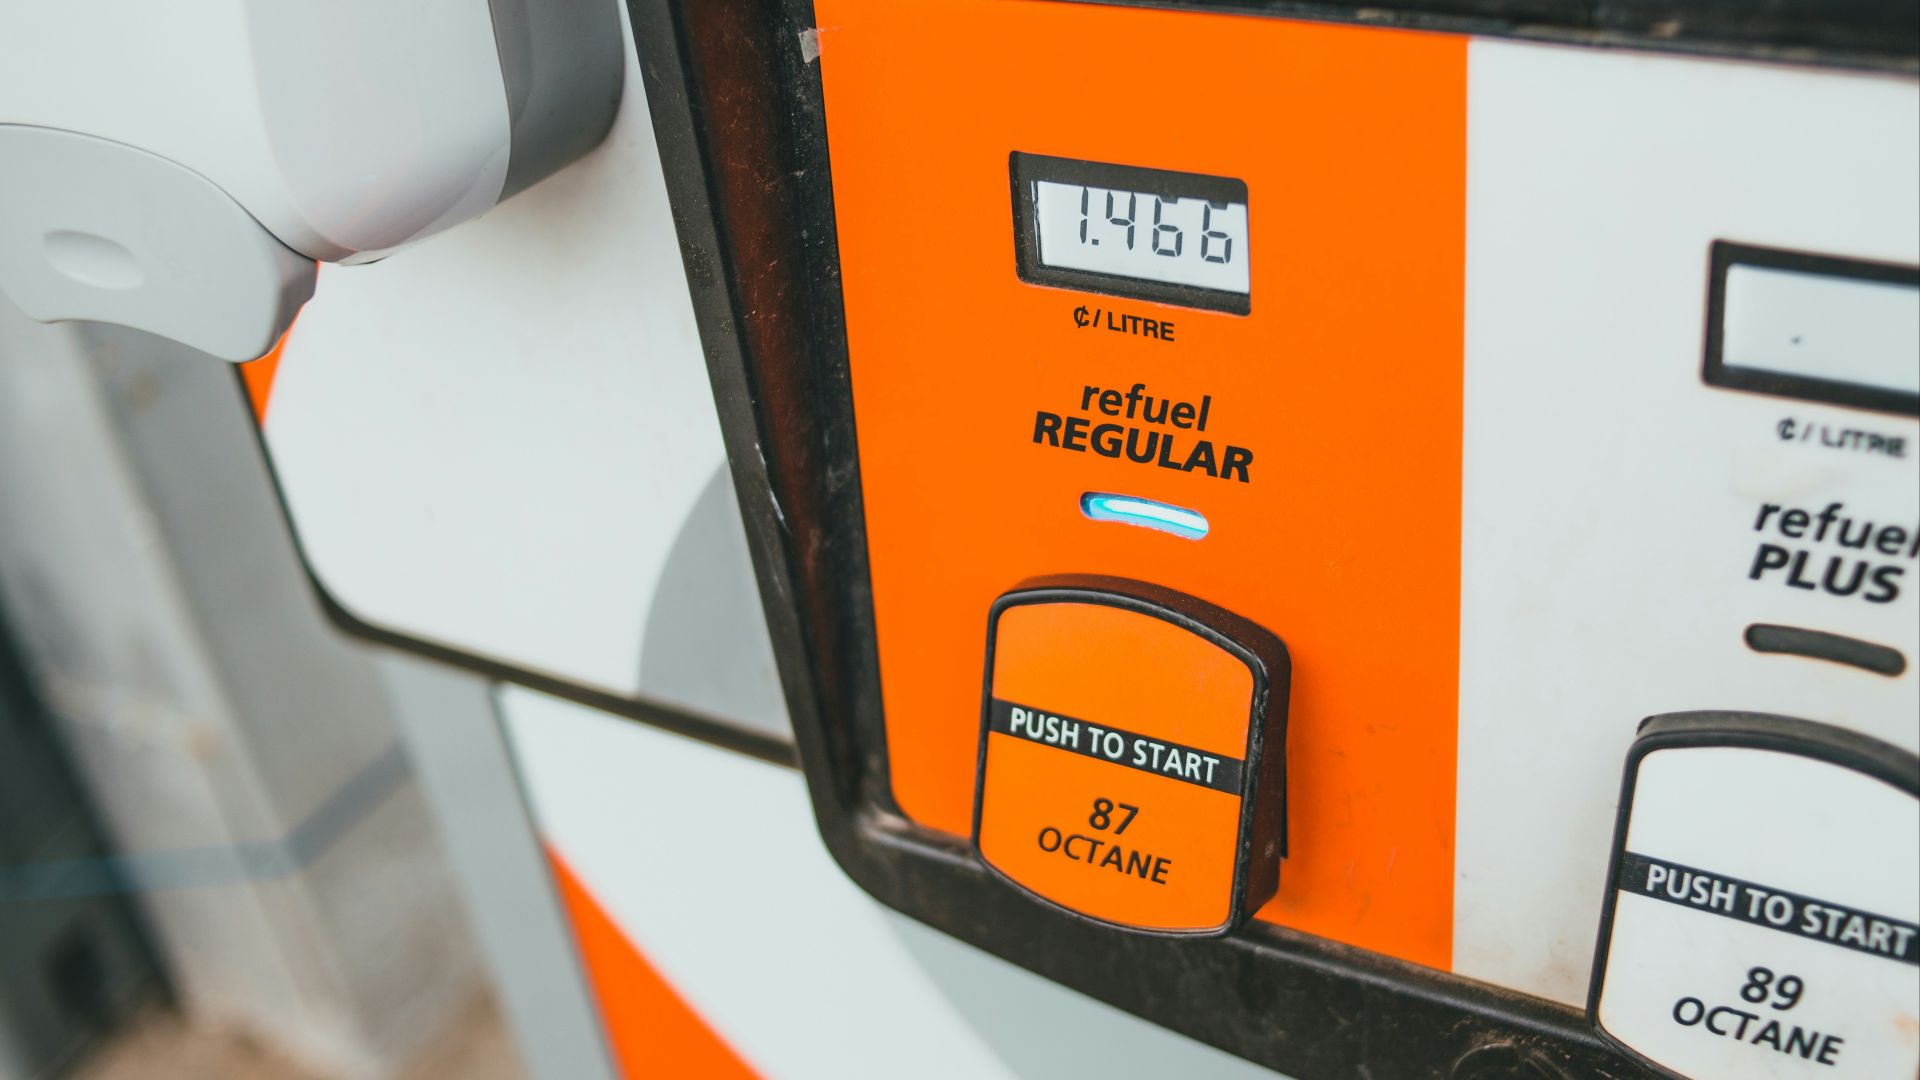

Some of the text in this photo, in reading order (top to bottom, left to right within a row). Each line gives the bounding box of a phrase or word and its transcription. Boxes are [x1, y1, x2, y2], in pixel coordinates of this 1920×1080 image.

[1079, 184, 1232, 264] 1.466
[1107, 311, 1175, 342] LITRE
[1081, 383, 1211, 432] refuel
[1032, 411, 1254, 483] REGULAR
[1820, 425, 1907, 459] LITRE
[1748, 543, 1904, 604] PLUS
[1010, 707, 1219, 783] PUSH TO START
[1088, 797, 1139, 835] 87
[1037, 827, 1172, 885] OCTANE
[1645, 863, 1917, 957] PUSH TO START
[1739, 966, 1805, 1011] 89
[1671, 996, 1845, 1066] OCTANE
